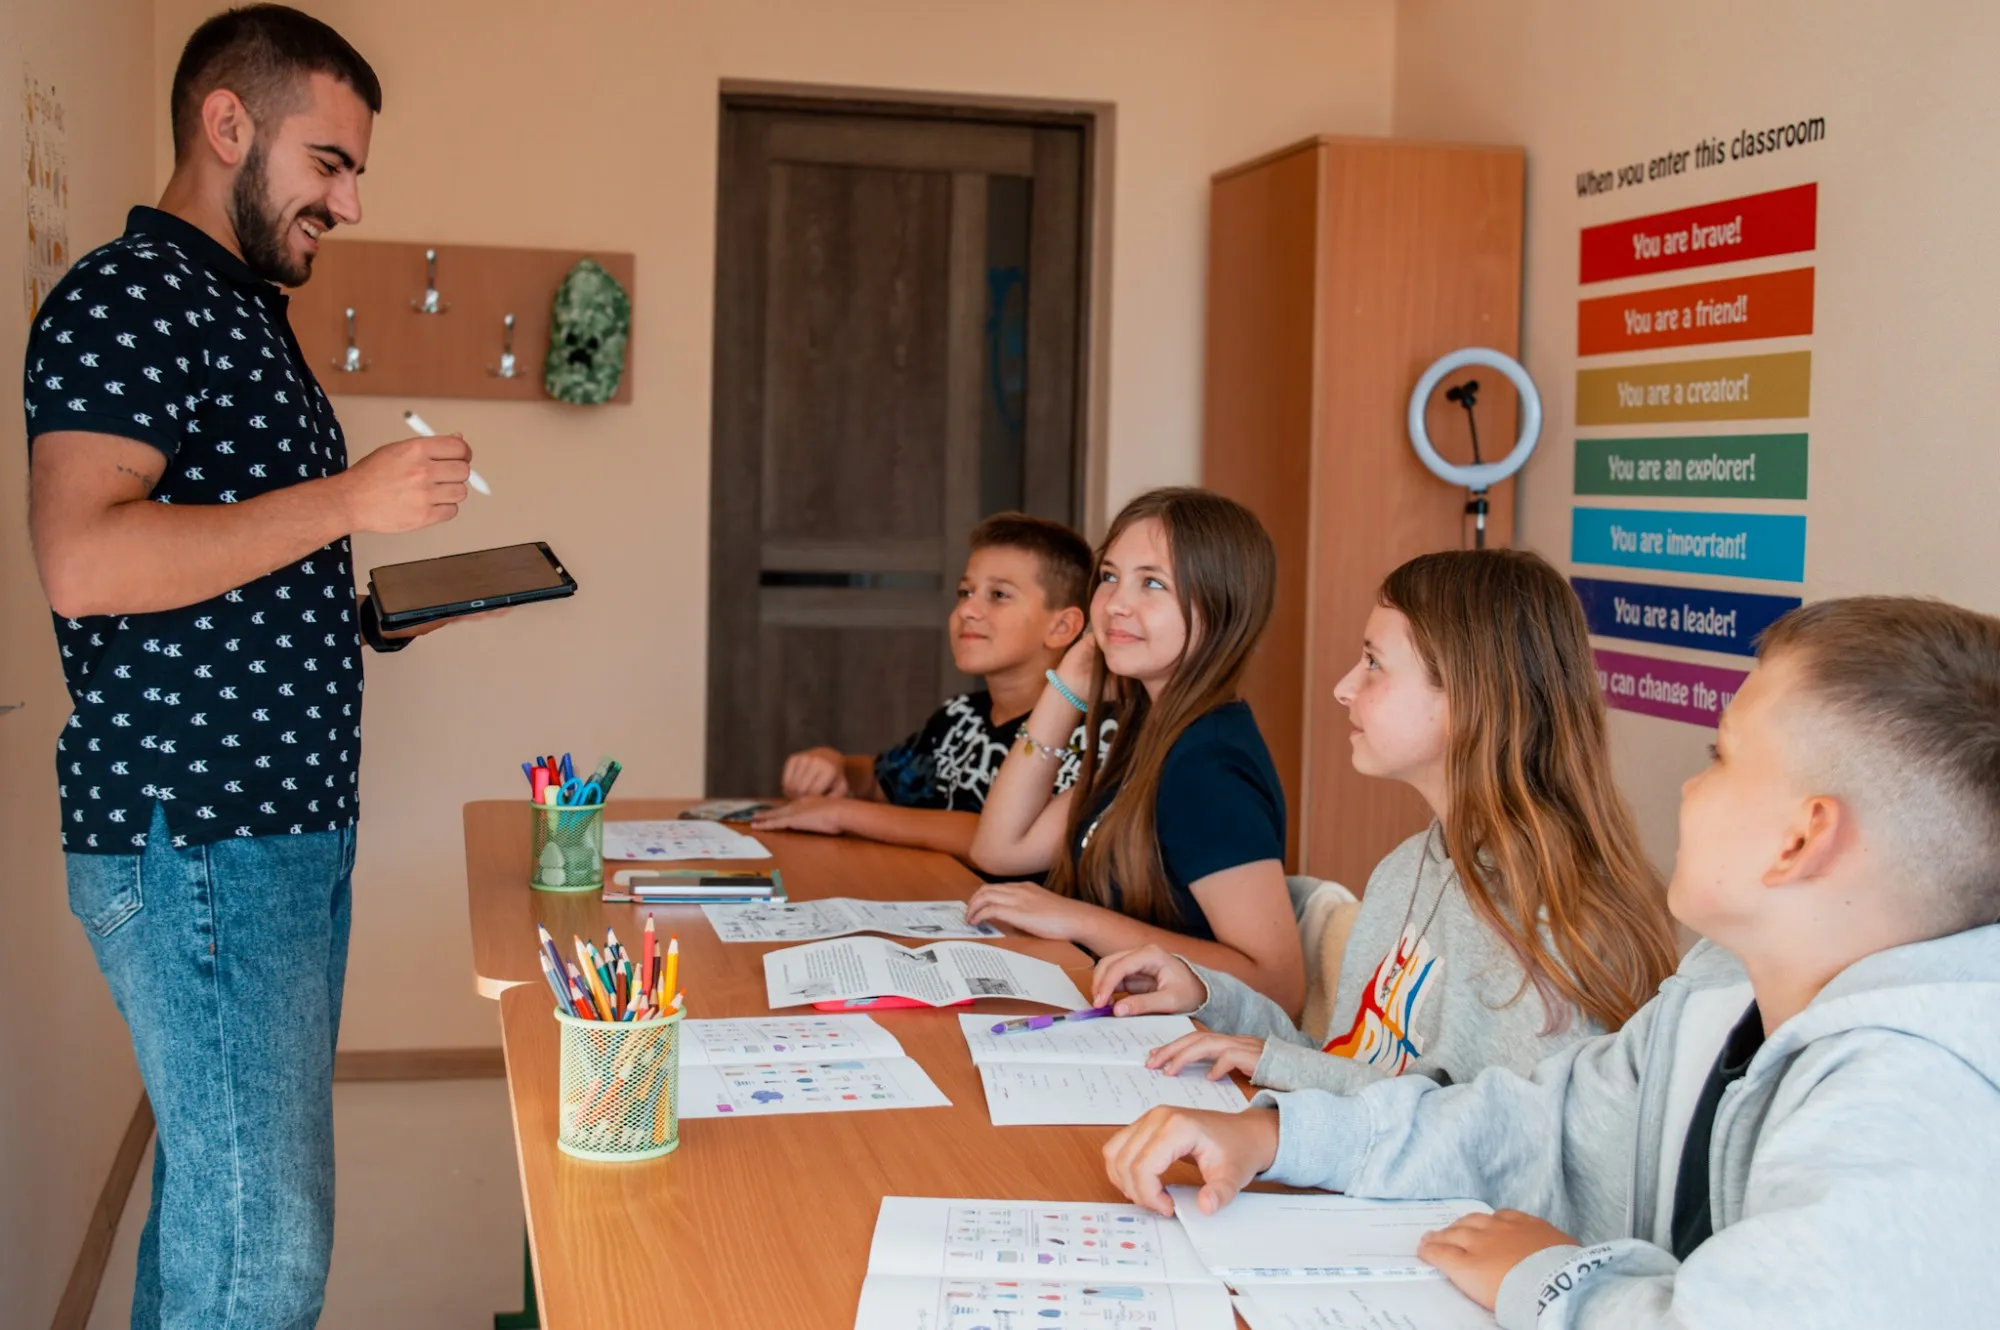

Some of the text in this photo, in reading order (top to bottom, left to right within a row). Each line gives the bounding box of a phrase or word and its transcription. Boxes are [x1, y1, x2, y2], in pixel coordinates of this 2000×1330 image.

[1577, 118, 1824, 196] When you enter this classroom
[1633, 216, 1741, 259] You are brave!
[1625, 295, 1748, 334] You are a friend!
[1618, 373, 1749, 407] You are a creator!
[1608, 453, 1755, 481] You are an explorer!
[1611, 526, 1746, 560] You are important!
[1614, 597, 1736, 637] You are a leader!
[1610, 673, 1636, 696] can
[1638, 673, 1689, 706] change
[1693, 682, 1717, 711] the
